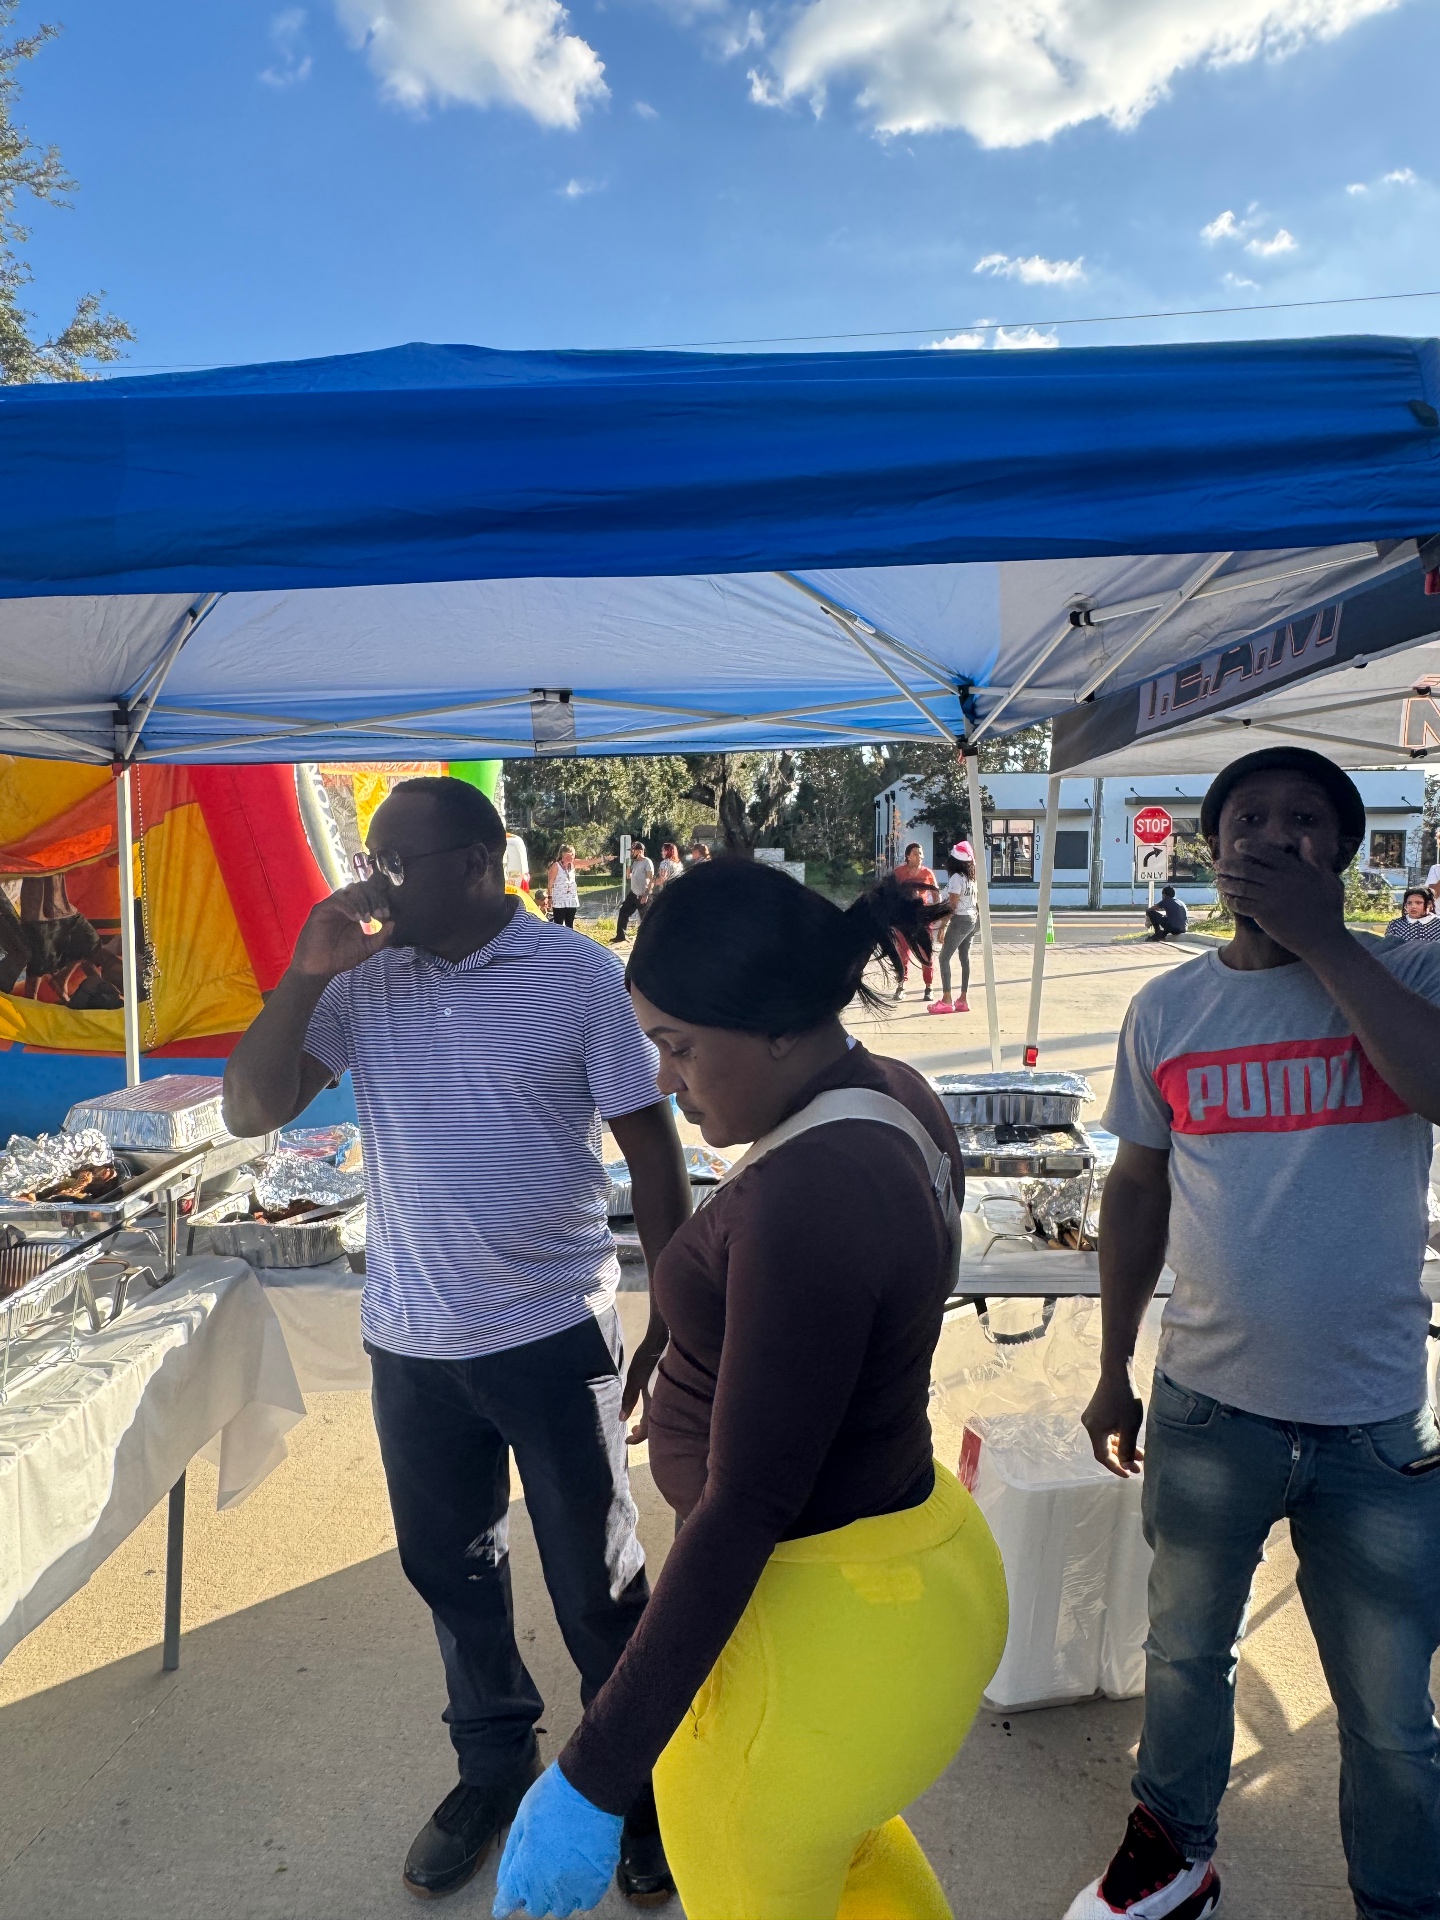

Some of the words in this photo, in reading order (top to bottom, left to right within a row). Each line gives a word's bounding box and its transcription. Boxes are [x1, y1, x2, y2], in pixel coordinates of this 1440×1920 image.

[306, 763, 354, 880] RAYON
[1136, 818, 1170, 833] STOP
[1140, 871, 1164, 880] ONLY
[1186, 1050, 1363, 1121] PUMA
